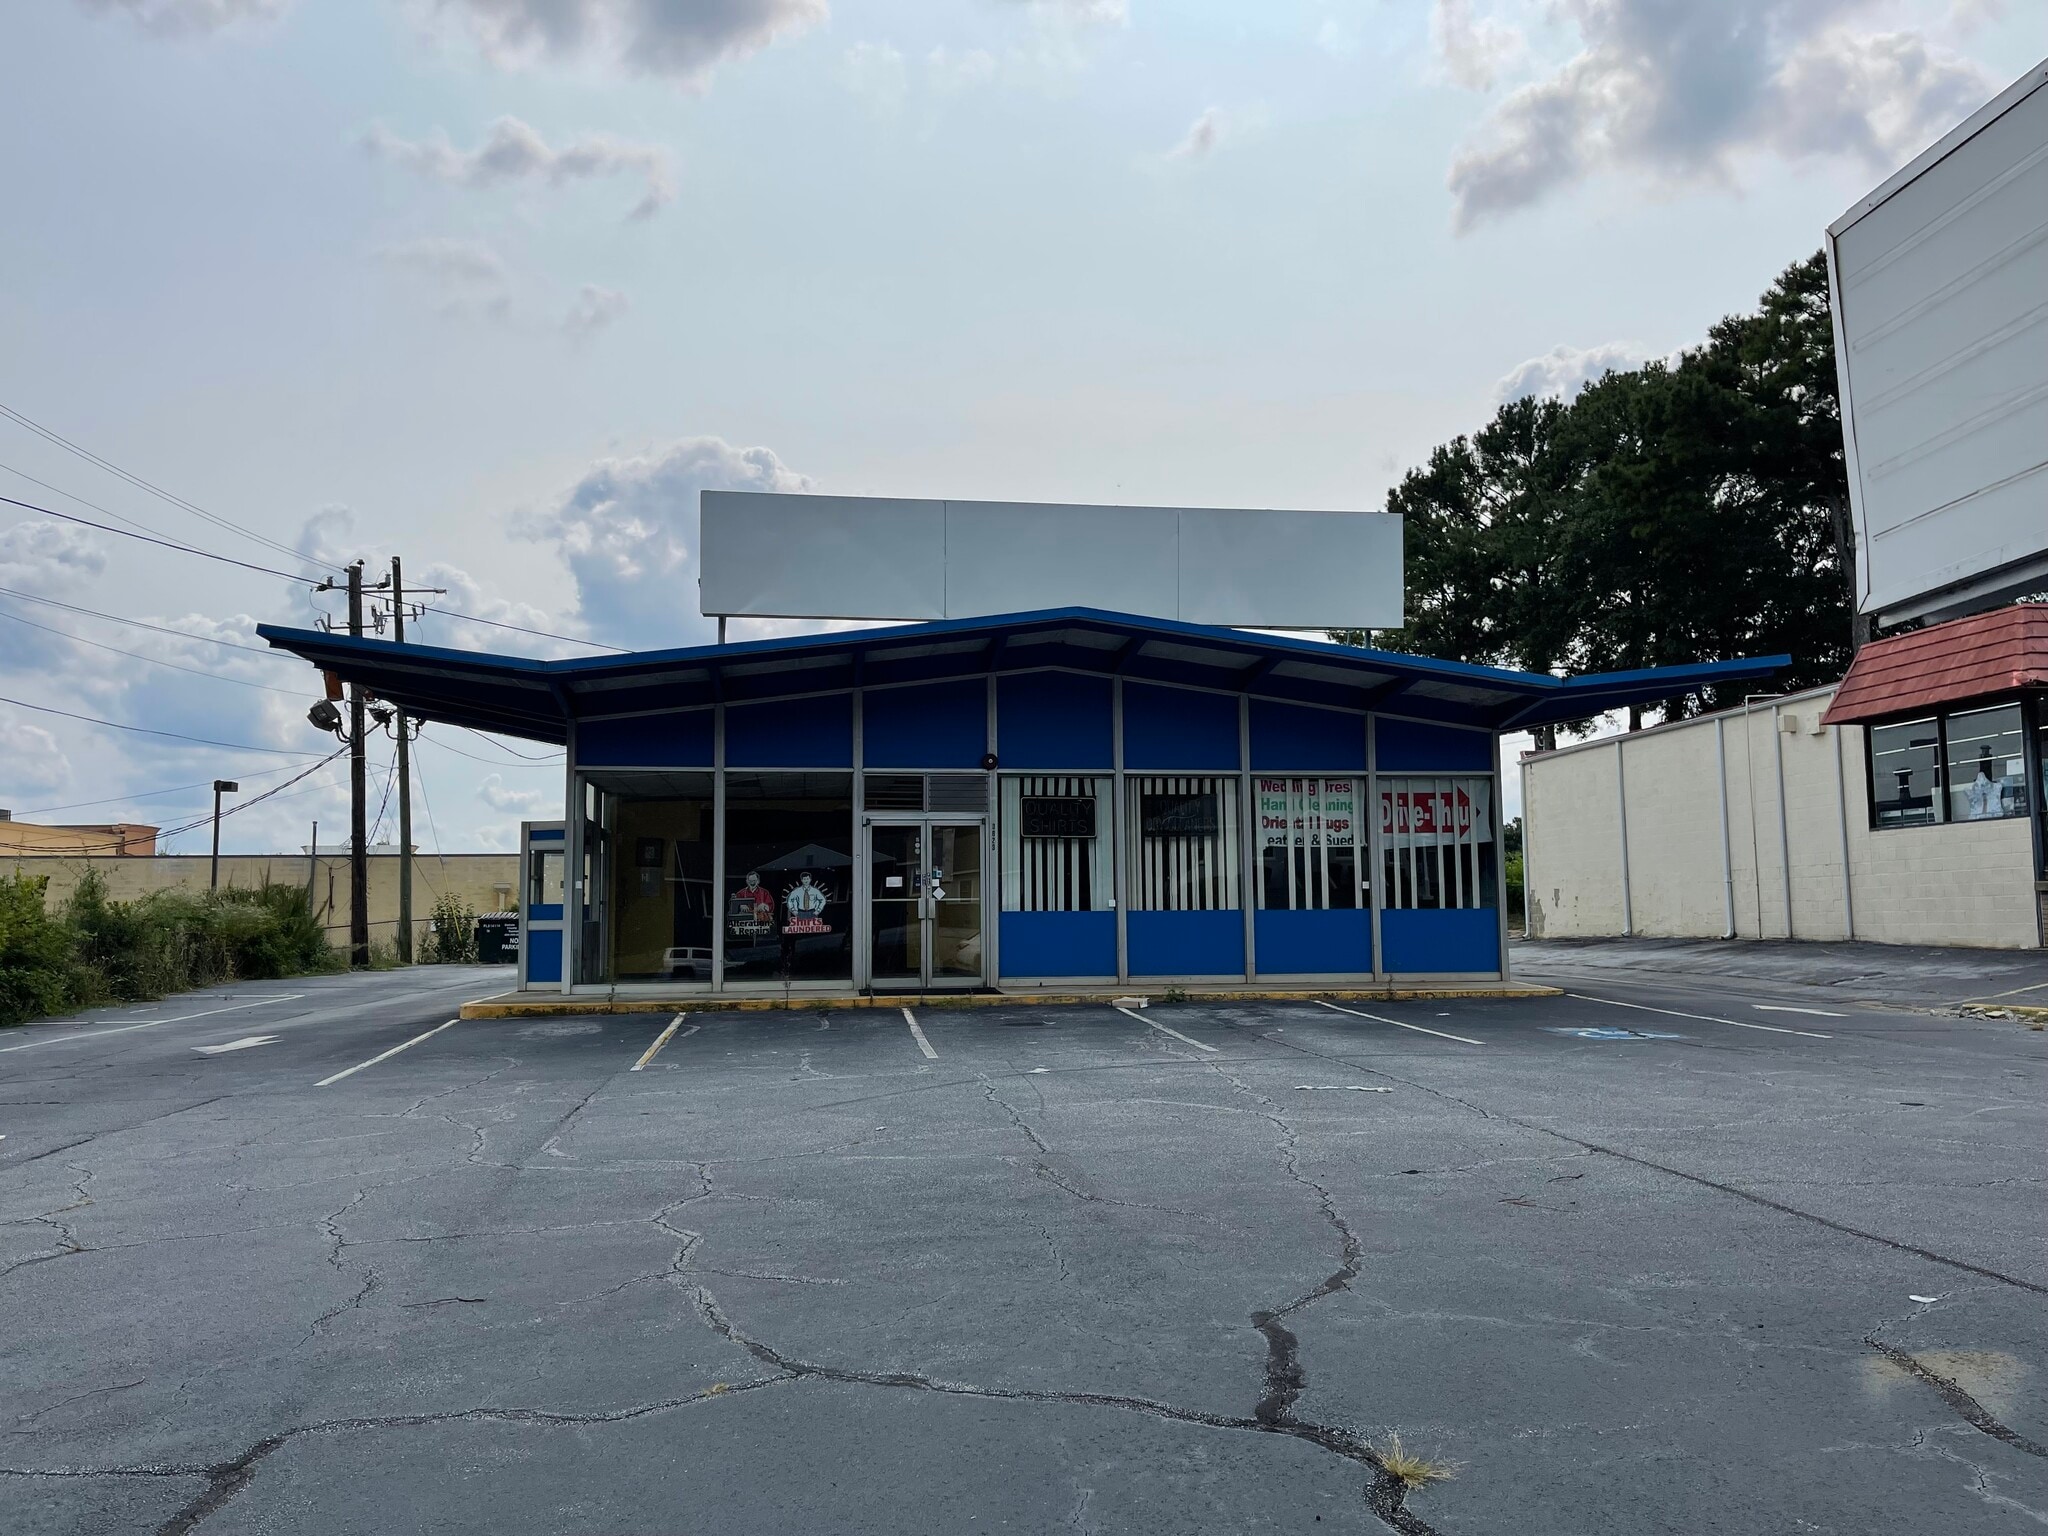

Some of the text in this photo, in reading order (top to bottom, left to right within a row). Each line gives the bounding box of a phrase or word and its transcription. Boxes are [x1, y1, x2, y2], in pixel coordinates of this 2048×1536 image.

[1025, 799, 1093, 816] QUALITY
[1261, 797, 1295, 811] Han
[1030, 818, 1088, 834] SHIRTS
[1311, 833, 1321, 846] &
[1326, 833, 1355, 846] Sued
[728, 919, 775, 928] Alterations
[790, 917, 823, 926] Shirts
[739, 927, 770, 936] Repairs
[782, 925, 831, 933] LAUNDERED
